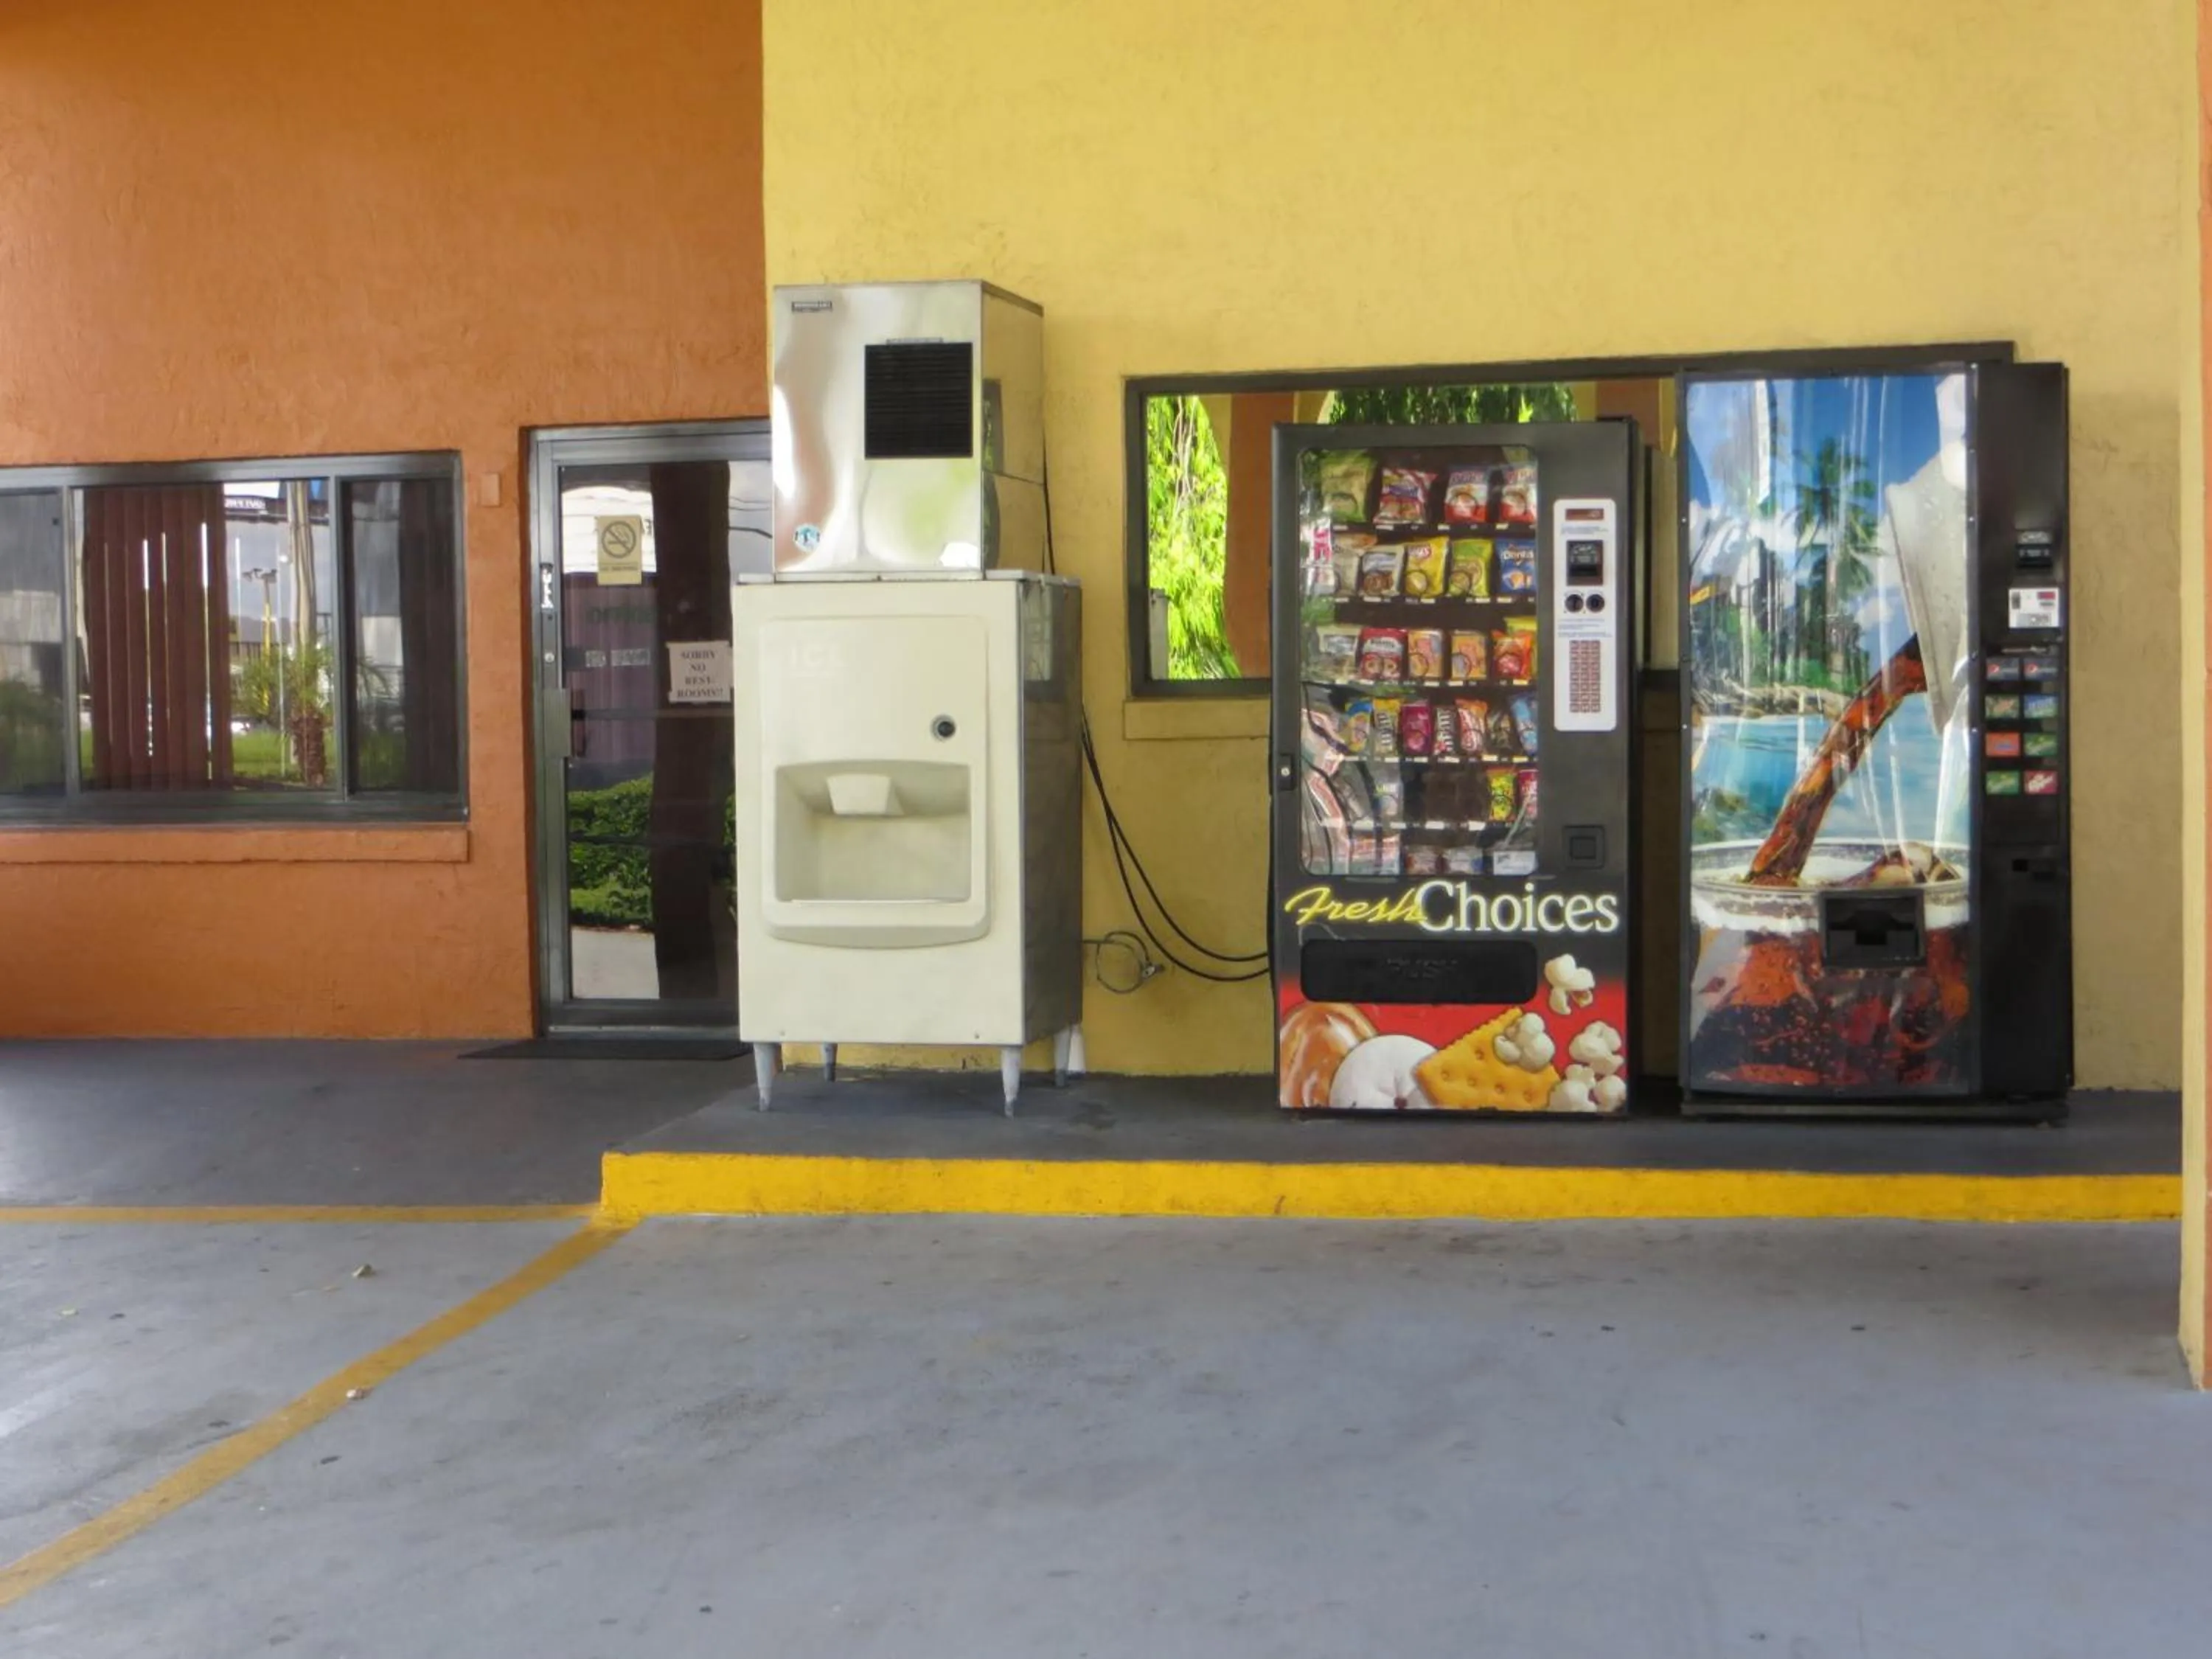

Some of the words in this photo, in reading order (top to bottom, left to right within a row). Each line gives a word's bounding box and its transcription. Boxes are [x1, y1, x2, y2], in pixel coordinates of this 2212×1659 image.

[689, 663, 707, 672] NO
[1284, 886, 1427, 925] Fresh
[1414, 880, 1620, 933] Choices
